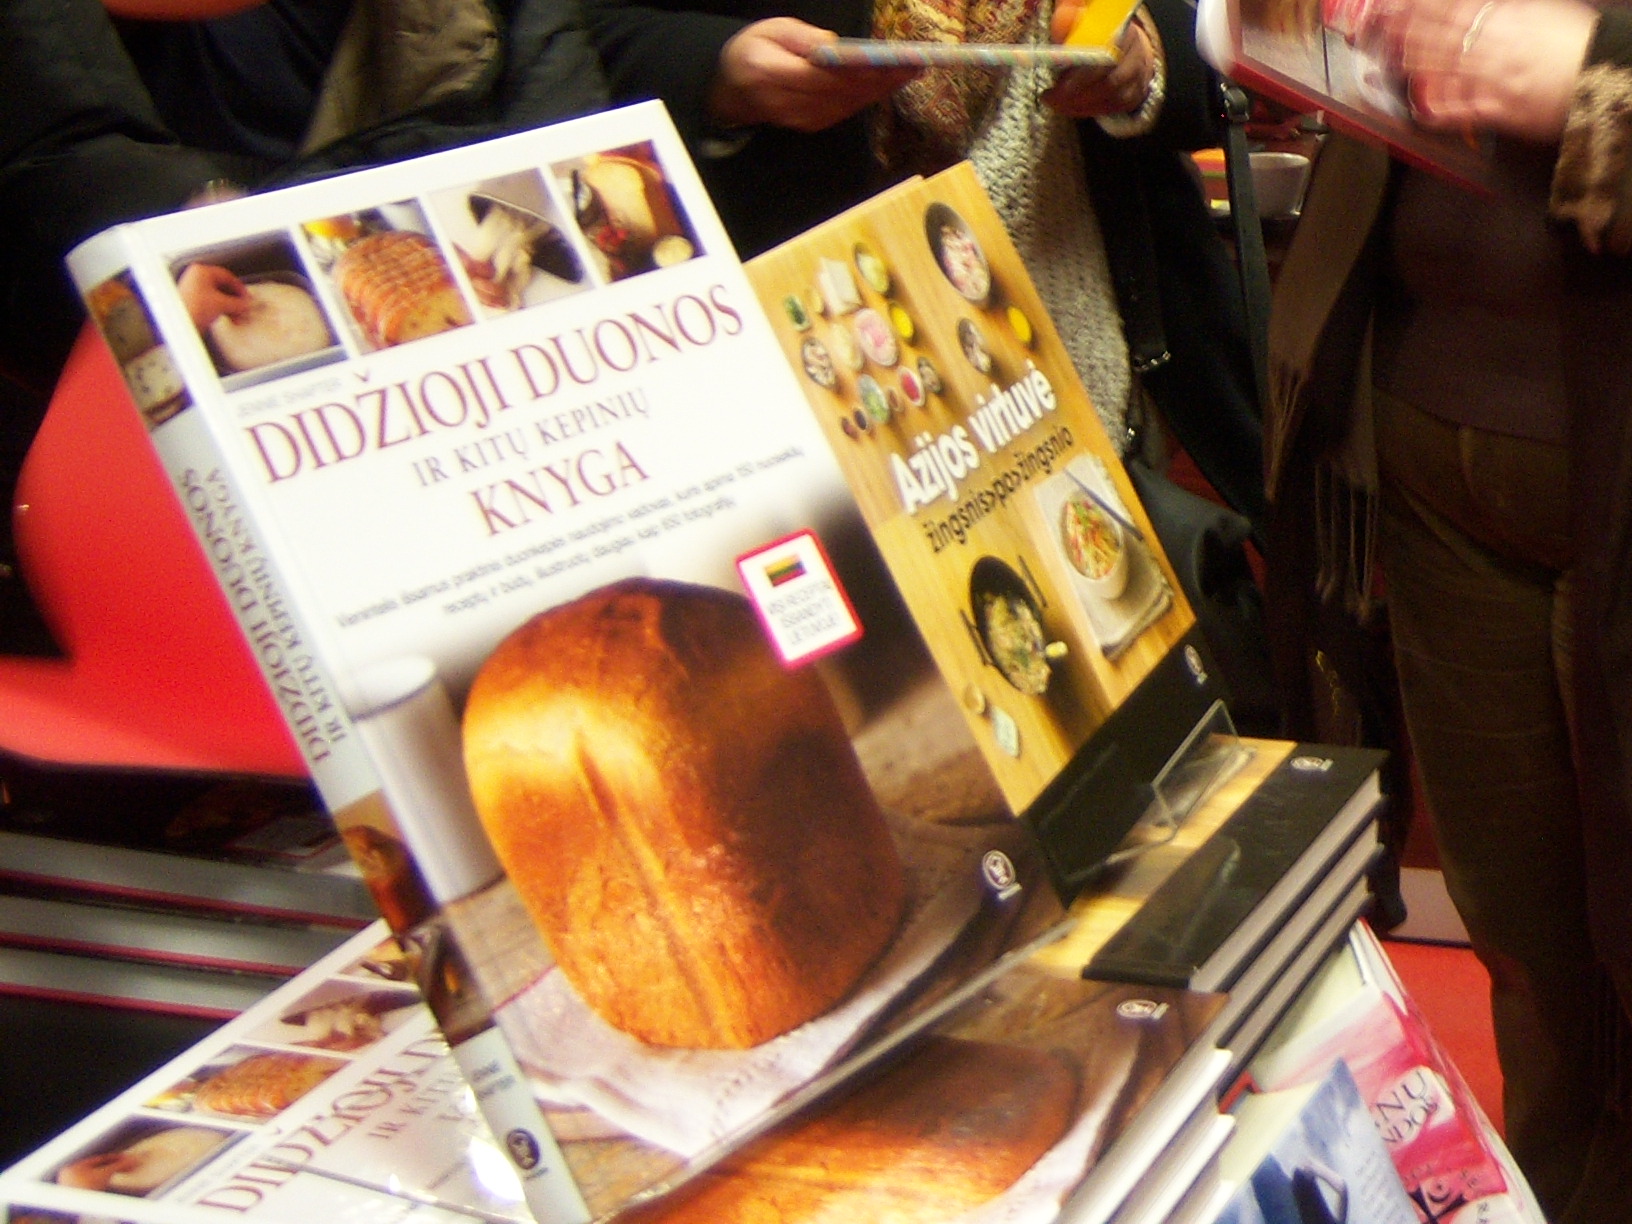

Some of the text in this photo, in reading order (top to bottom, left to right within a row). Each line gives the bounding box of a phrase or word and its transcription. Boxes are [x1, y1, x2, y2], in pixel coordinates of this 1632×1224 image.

[245, 283, 744, 484] DIDŽIOJI DUONOS
[411, 460, 450, 489] IR
[467, 440, 651, 538] KNYGA
